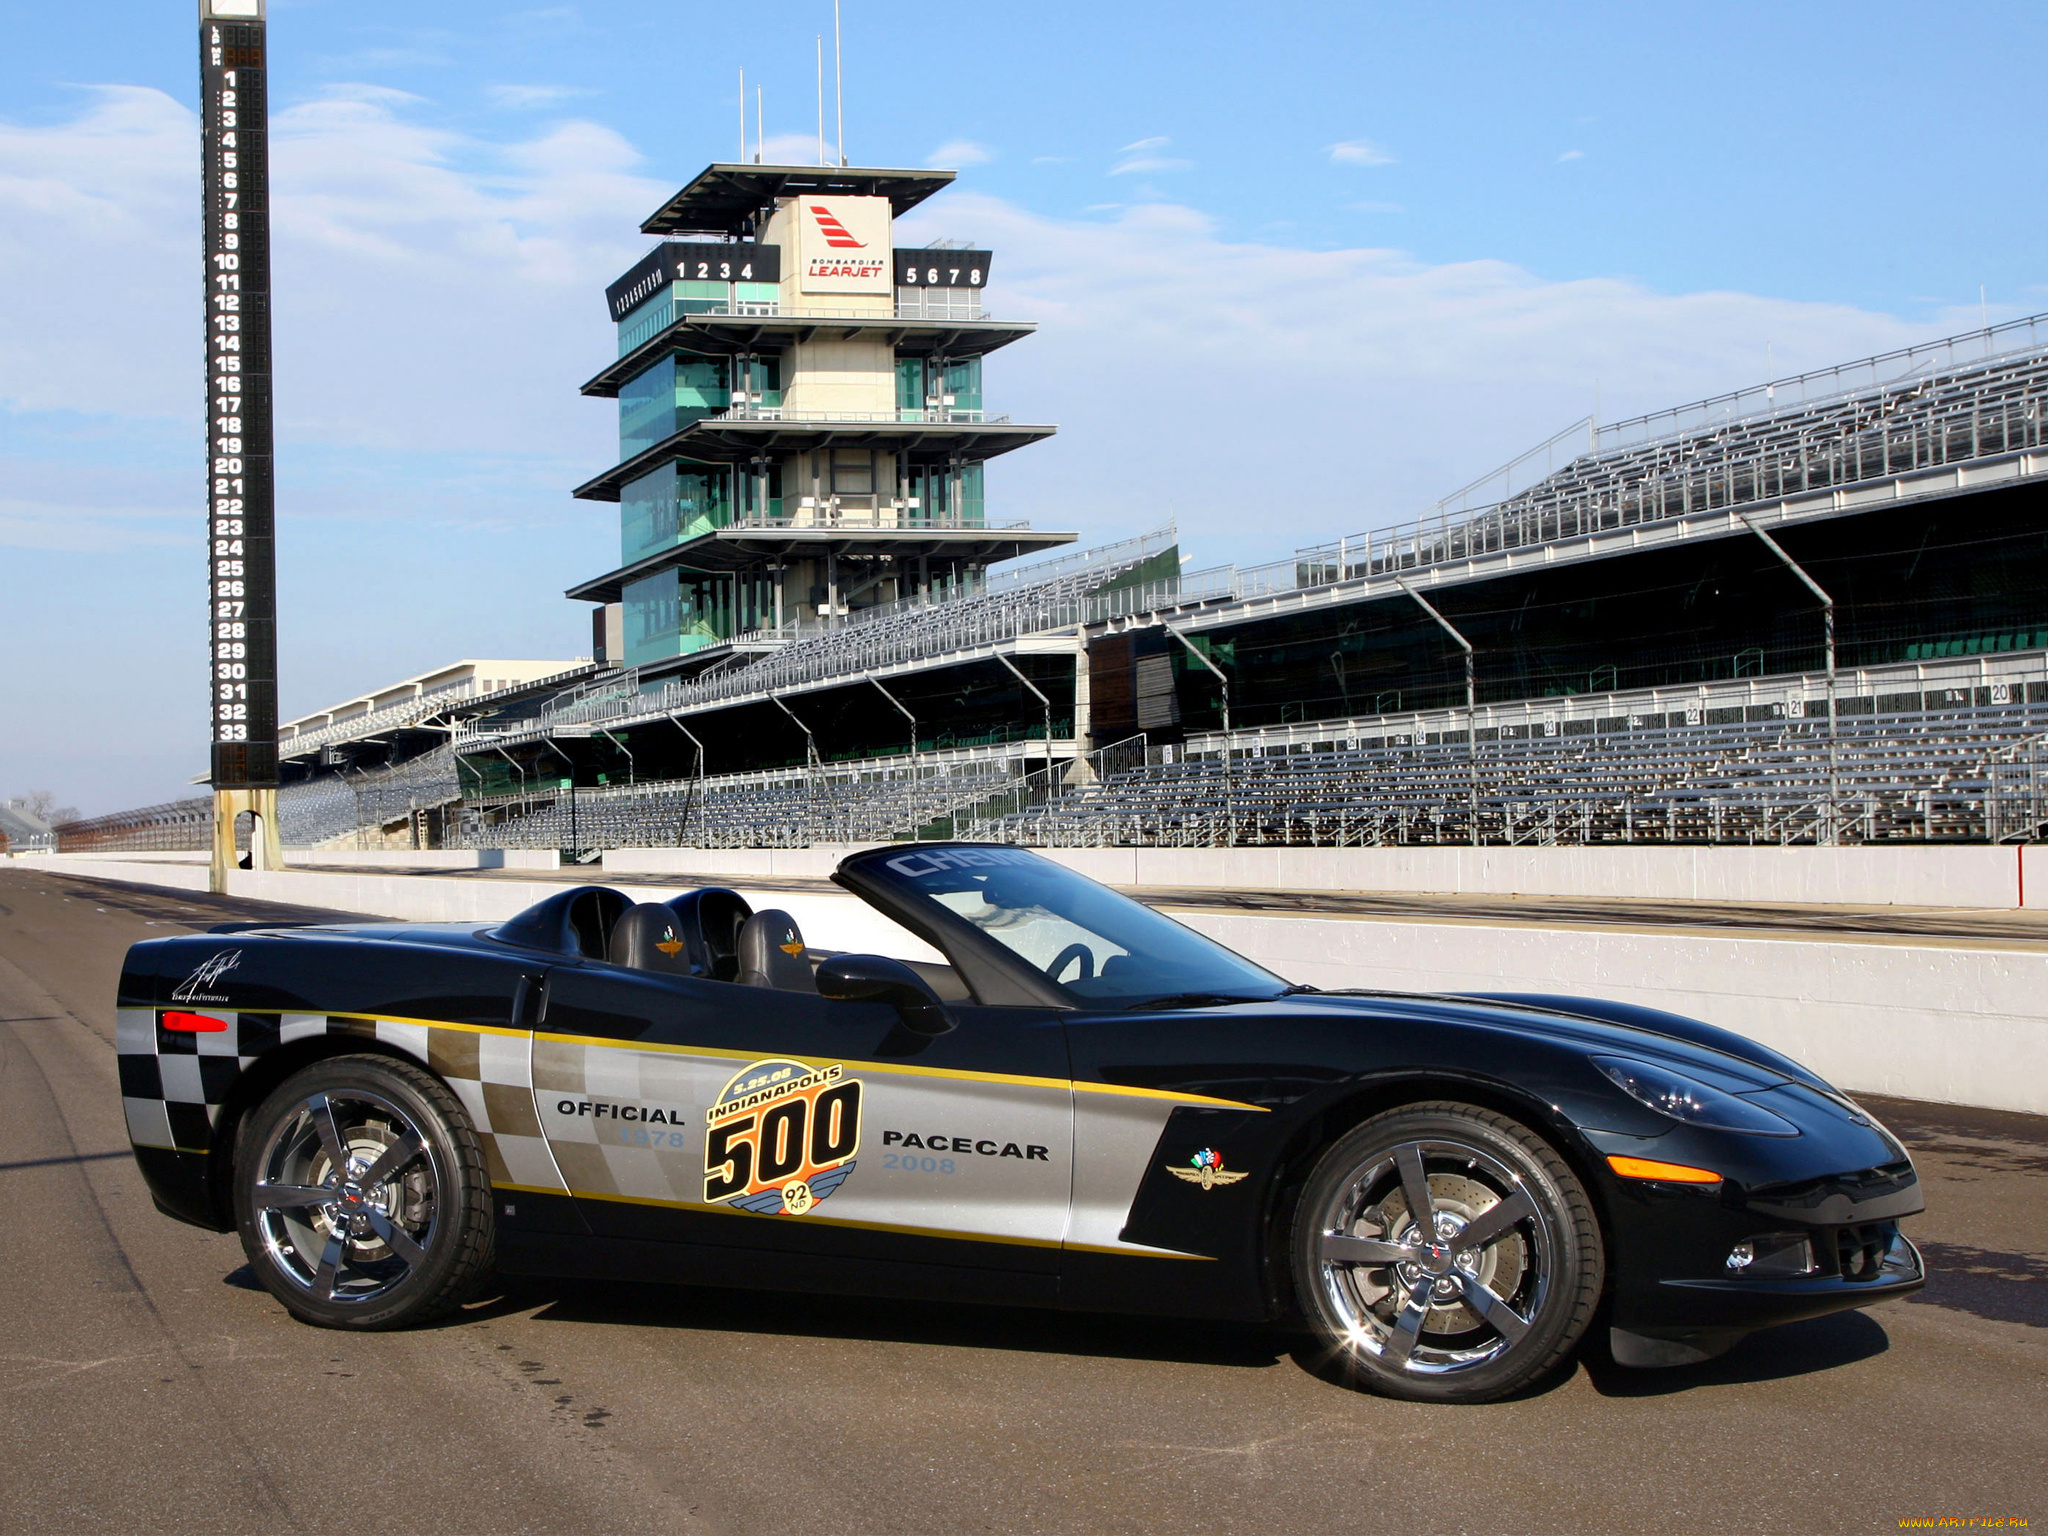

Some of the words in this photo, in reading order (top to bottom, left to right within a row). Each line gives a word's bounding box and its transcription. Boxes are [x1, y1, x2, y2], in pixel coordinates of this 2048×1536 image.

[223, 71, 236, 87] 1
[222, 91, 237, 107] 2
[222, 111, 237, 128] 3
[221, 132, 237, 149] 4
[223, 152, 238, 169] 5
[223, 172, 238, 189] 6
[224, 193, 238, 209] 7
[224, 213, 239, 230] 8
[224, 234, 239, 250] 9
[213, 254, 239, 271] 10
[811, 258, 884, 266] BOMBARDIER
[676, 262, 685, 278] 1
[697, 262, 709, 278] 2
[720, 262, 731, 279] 3
[741, 263, 753, 280] 4
[808, 266, 882, 277] LEARJET
[906, 267, 917, 284] 5
[927, 268, 938, 284] 6
[949, 269, 960, 284] 7
[970, 269, 981, 285] 8
[215, 275, 240, 291] 11
[213, 295, 240, 312] 12
[214, 315, 240, 332] 13
[214, 335, 241, 352] 14
[214, 356, 241, 372] 15
[215, 376, 241, 393] 16
[215, 397, 242, 413] 17
[215, 417, 242, 434] 18
[216, 438, 242, 454] 19
[214, 458, 243, 475] 20
[214, 479, 243, 495] 21
[215, 499, 244, 516] 22
[215, 520, 244, 536] 23
[215, 540, 244, 557] 24
[217, 561, 244, 577] 25
[217, 581, 245, 598] 26
[217, 601, 245, 618] 27
[217, 623, 246, 639] 28
[217, 643, 246, 660] 29
[217, 663, 246, 680] 30
[219, 684, 247, 700] 31
[1992, 684, 2008, 700] 20
[218, 704, 247, 721] 32
[1687, 708, 1698, 721] 22
[1791, 700, 1802, 714] 21
[218, 724, 248, 741] 33
[886, 850, 1040, 878] CHEVR
[733, 1067, 792, 1095] 5.25.08
[708, 1066, 841, 1121] INDIANAPOLIS
[557, 1100, 685, 1126] OFFICIAL
[883, 1130, 1050, 1162] PACECAR
[705, 1080, 862, 1202] 500
[617, 1128, 685, 1149] 1978
[883, 1153, 957, 1175] 2008
[785, 1184, 807, 1203] 92
[790, 1201, 806, 1211] ND
